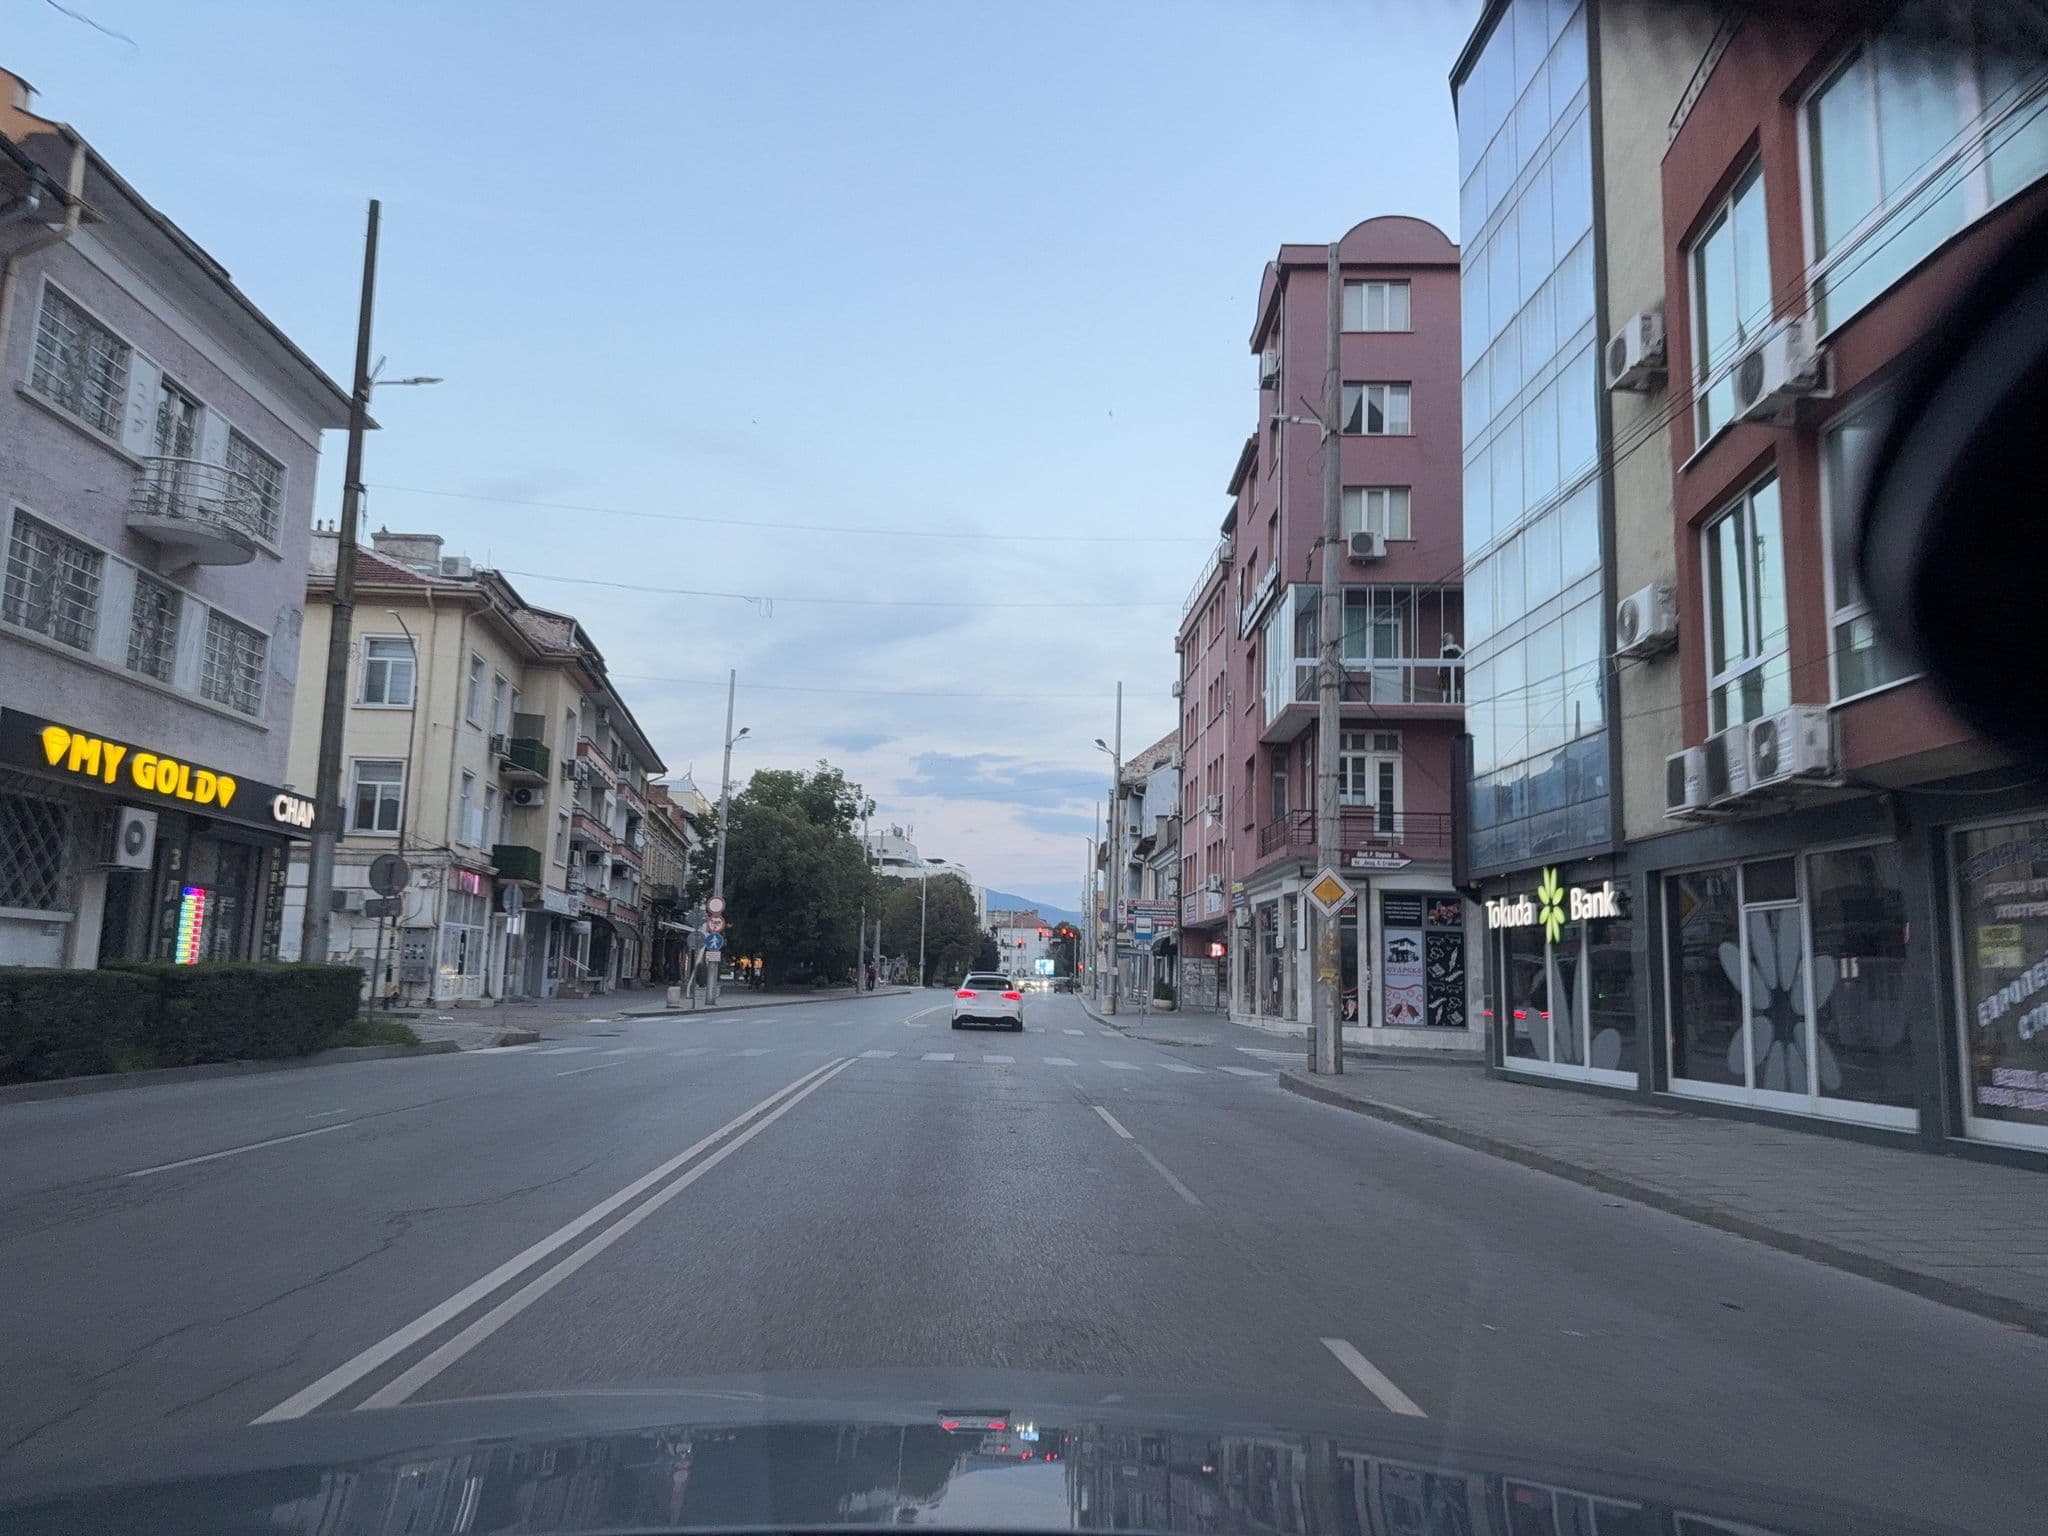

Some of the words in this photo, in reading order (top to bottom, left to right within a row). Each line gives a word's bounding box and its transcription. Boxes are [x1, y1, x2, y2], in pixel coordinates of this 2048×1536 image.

[67, 733, 127, 785] MY
[131, 752, 217, 804] GOLD
[1485, 893, 1536, 930] Tokuda
[1569, 880, 1619, 921] Bank
